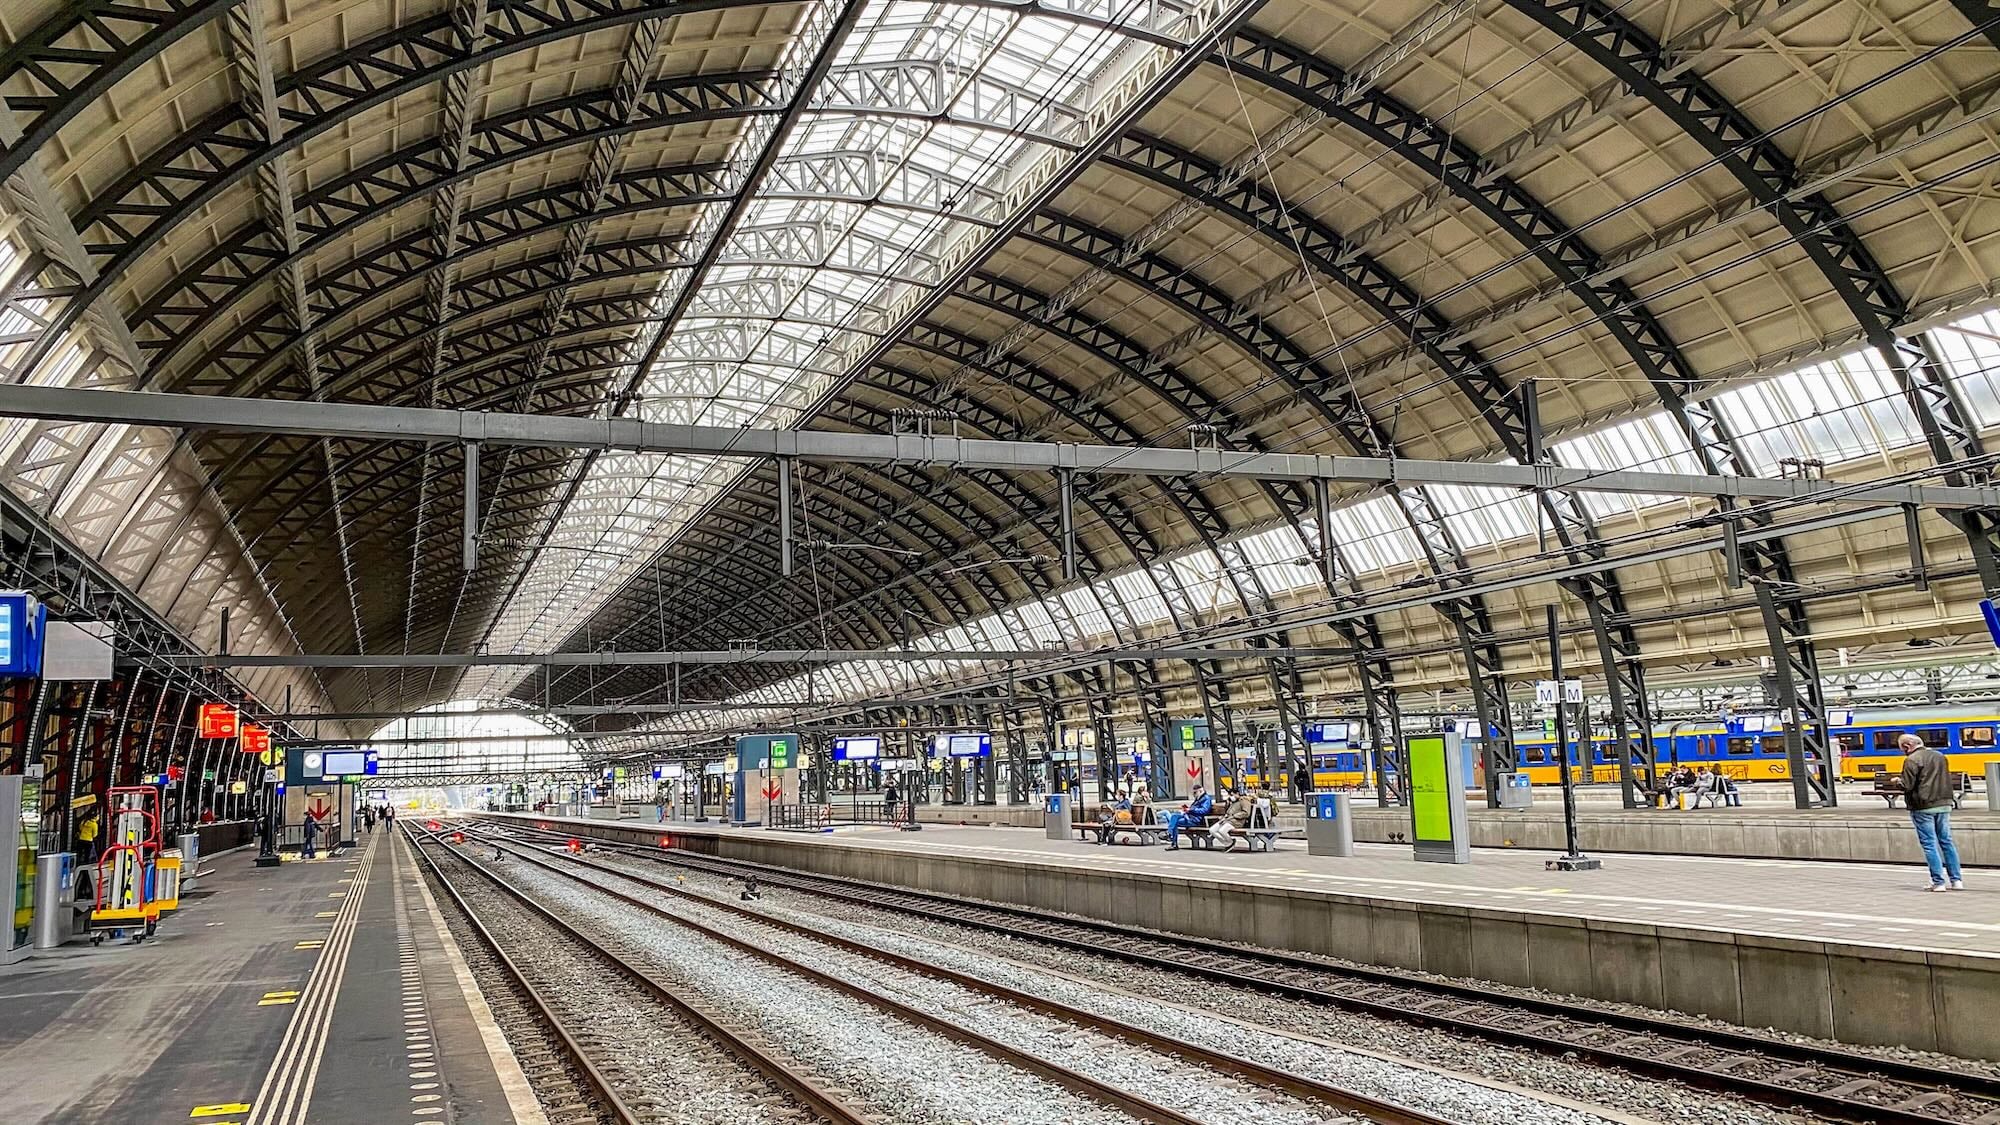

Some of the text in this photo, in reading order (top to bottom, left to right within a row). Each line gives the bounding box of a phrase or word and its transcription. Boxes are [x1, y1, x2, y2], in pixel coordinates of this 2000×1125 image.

[1541, 689, 1552, 701] M
[1568, 689, 1580, 701] M
[1754, 735, 1760, 743] 2
